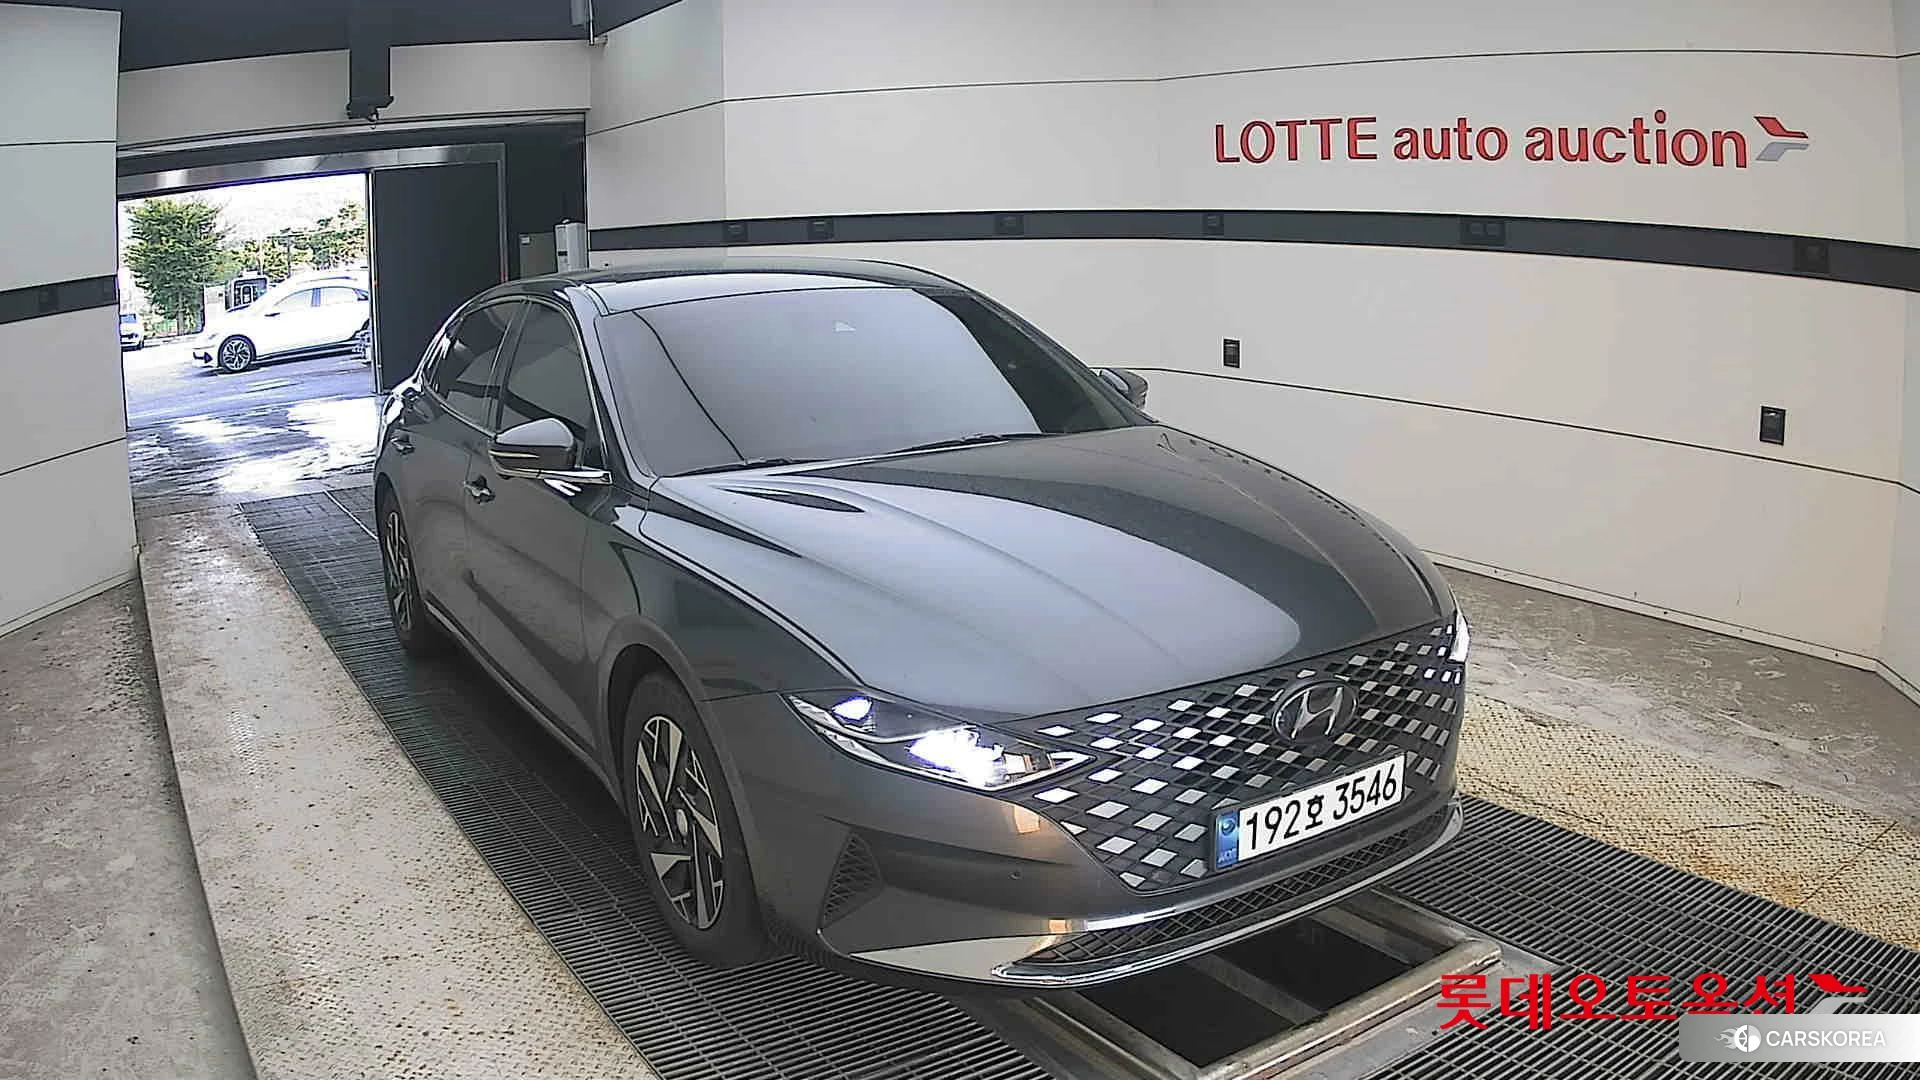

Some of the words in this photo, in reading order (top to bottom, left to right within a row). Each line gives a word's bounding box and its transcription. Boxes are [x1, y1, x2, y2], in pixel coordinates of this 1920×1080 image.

[1214, 116, 1378, 164] LOTTE
[1392, 116, 1509, 161] auto
[1523, 109, 1748, 168] auction
[1246, 795, 1325, 850] 192호
[1332, 763, 1397, 821] 3546
